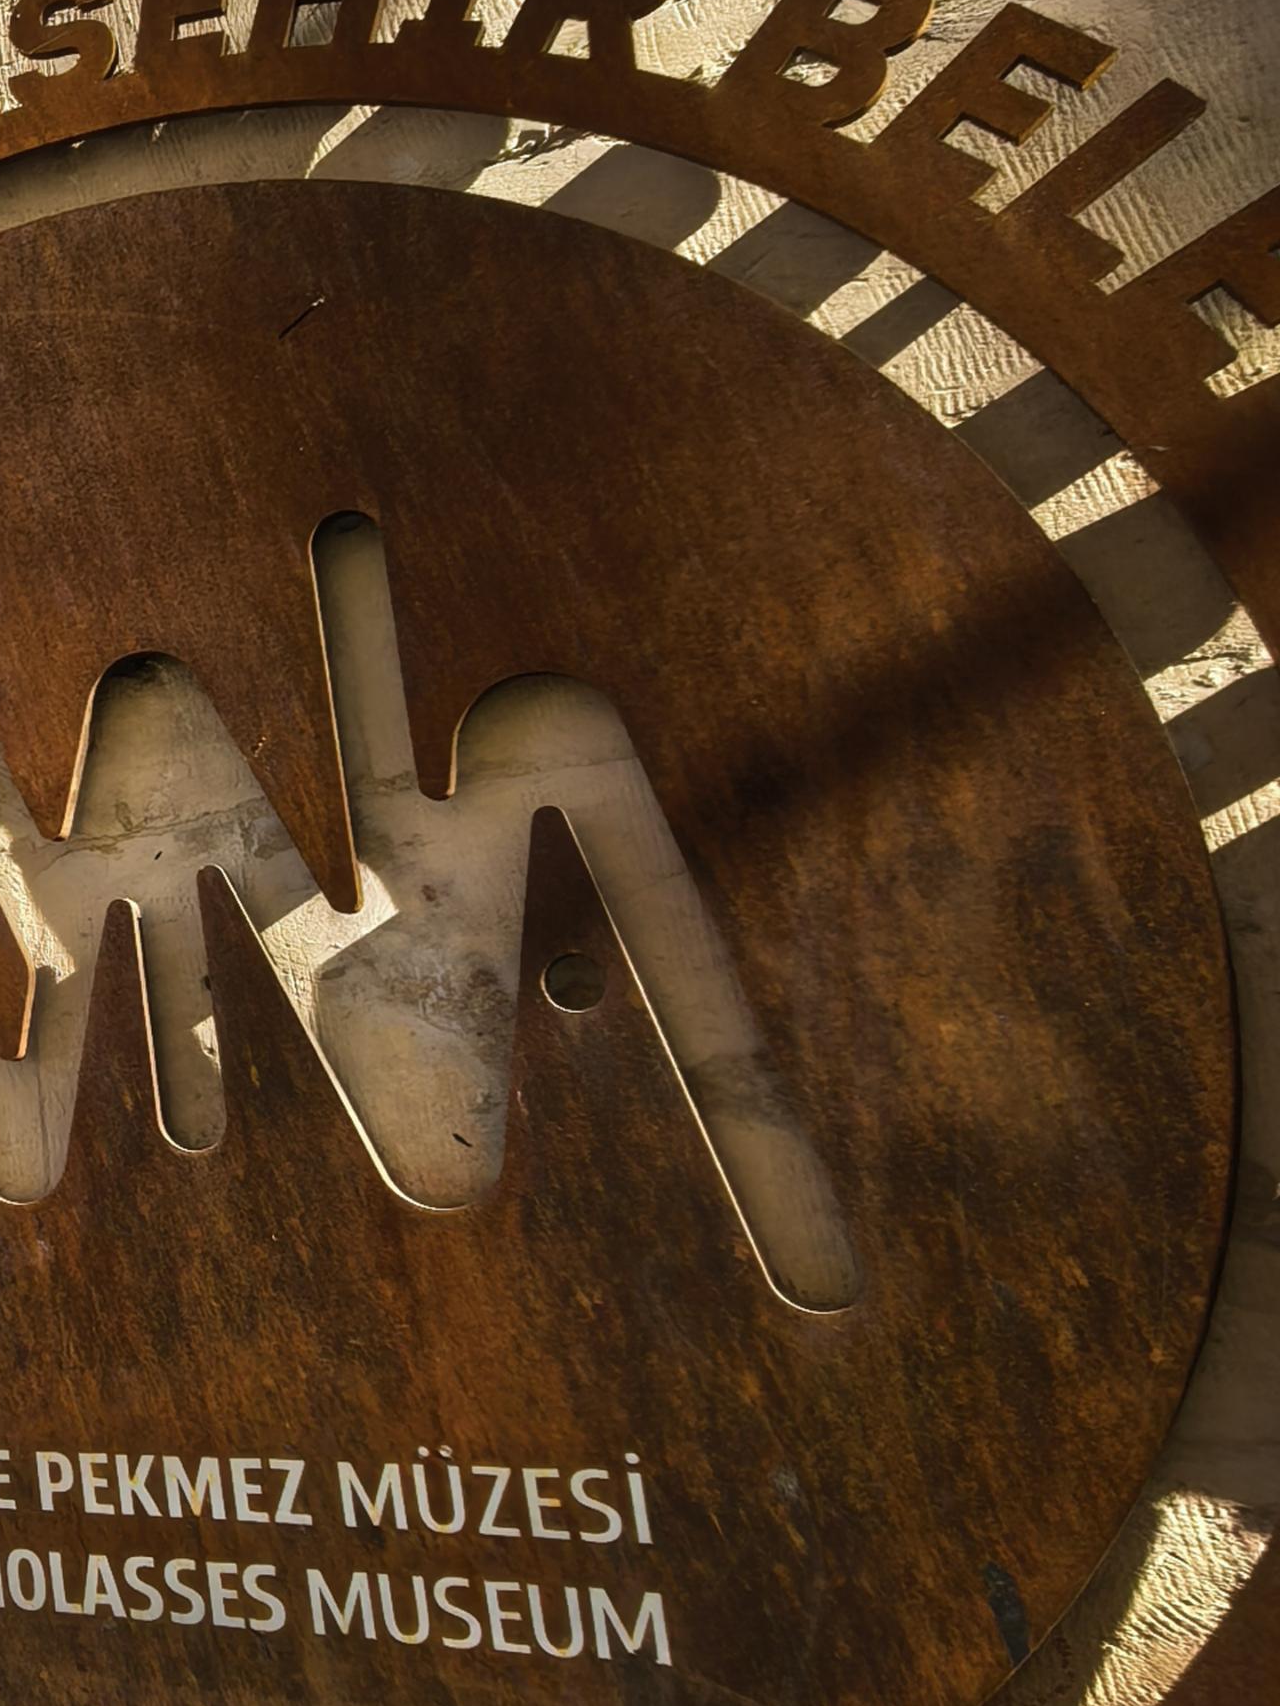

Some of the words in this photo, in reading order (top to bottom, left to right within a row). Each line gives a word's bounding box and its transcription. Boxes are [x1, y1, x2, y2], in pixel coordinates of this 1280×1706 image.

[36, 1451, 313, 1526] PEKMEZ
[337, 1445, 653, 1545] MÜZESİ
[306, 1568, 673, 1667] MUSEUM
